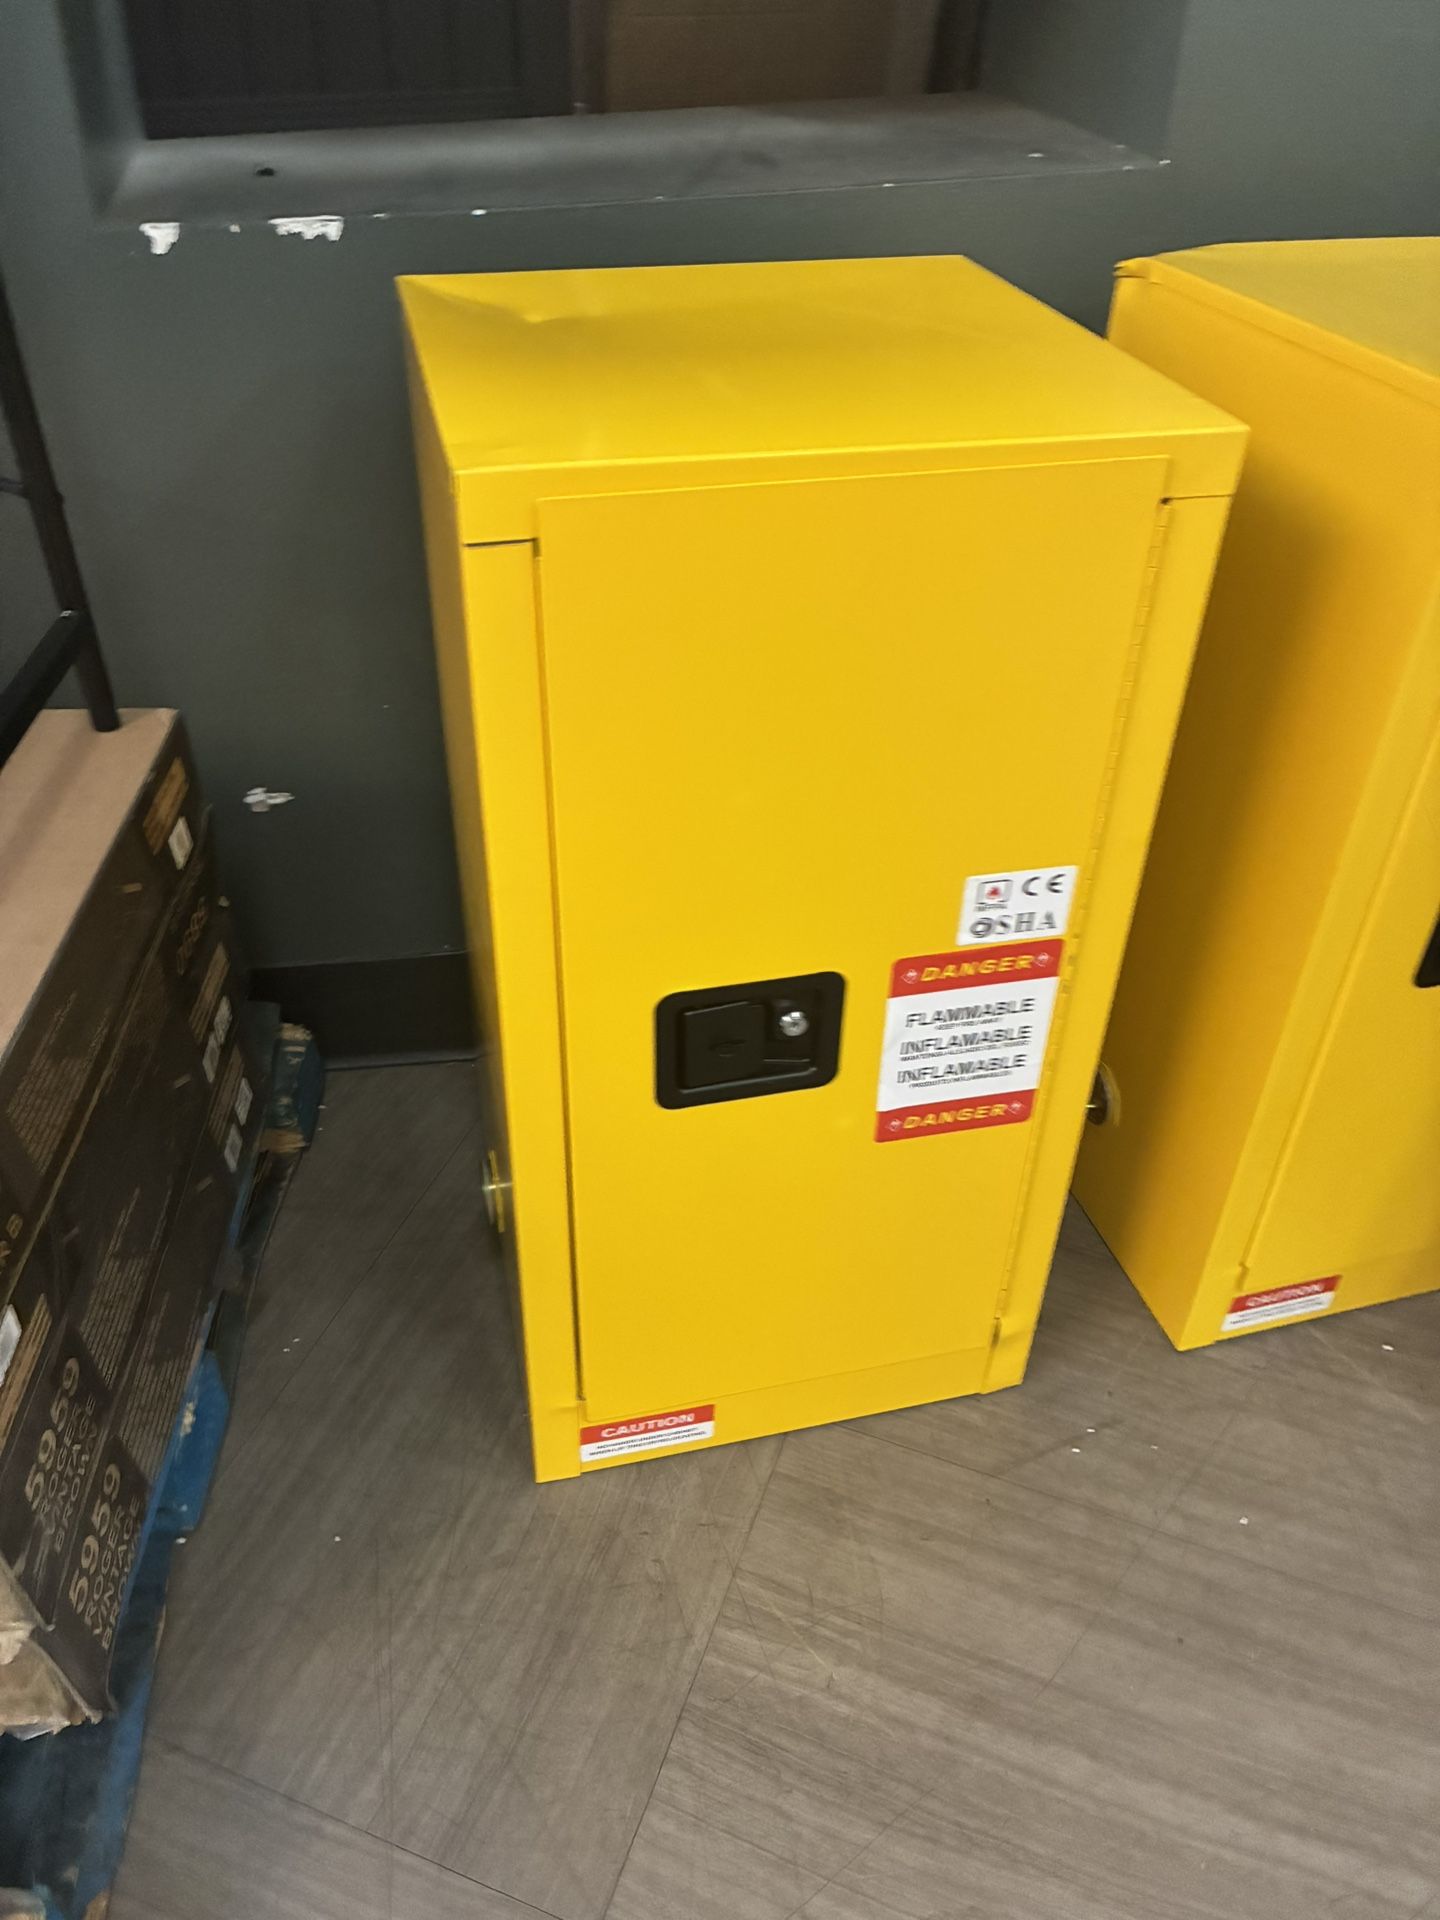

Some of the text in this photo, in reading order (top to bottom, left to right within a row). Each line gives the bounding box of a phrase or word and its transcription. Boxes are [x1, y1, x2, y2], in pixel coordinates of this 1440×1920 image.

[1021, 873, 1066, 896] CE
[969, 910, 1057, 938] OSHA
[920, 953, 1035, 983] DANGER
[905, 998, 1036, 1028] FLAMMABLE
[899, 1025, 1033, 1055] INFLAMABLE
[897, 1054, 1027, 1084] INFLAMABLE
[903, 1103, 1010, 1130] DANGER
[25, 1357, 80, 1511] 5959
[600, 1412, 696, 1438] CAUTION
[40, 1402, 81, 1522] ROGER
[69, 1463, 121, 1614] 5959
[84, 1504, 125, 1627] ROGER
[93, 1496, 141, 1636] VINTAGE
